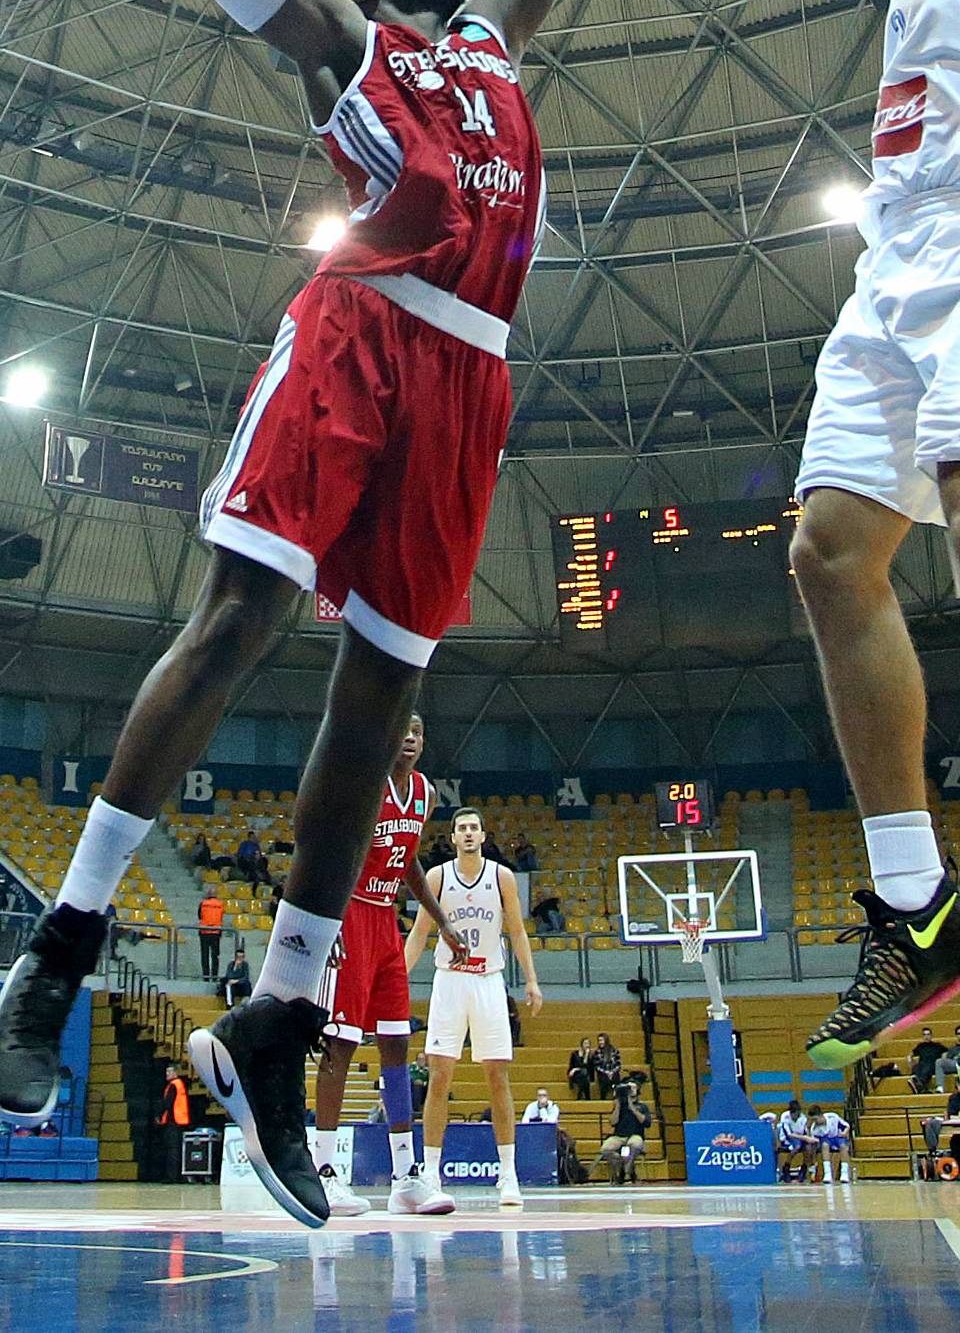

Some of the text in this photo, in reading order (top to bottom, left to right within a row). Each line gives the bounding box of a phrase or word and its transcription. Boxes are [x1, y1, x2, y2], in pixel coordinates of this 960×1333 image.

[454, 85, 497, 137] 14
[143, 462, 163, 472] KUP
[664, 508, 677, 528] 5
[185, 770, 214, 802] B
[433, 778, 462, 808] N
[556, 777, 589, 807] A
[676, 800, 702, 825] 15
[386, 845, 406, 868] 22
[365, 876, 400, 894] Stradi
[448, 905, 495, 923] CIBONA
[460, 928, 480, 948] 19
[697, 1145, 763, 1171] Zagreb
[443, 1161, 501, 1178] CIBONA
